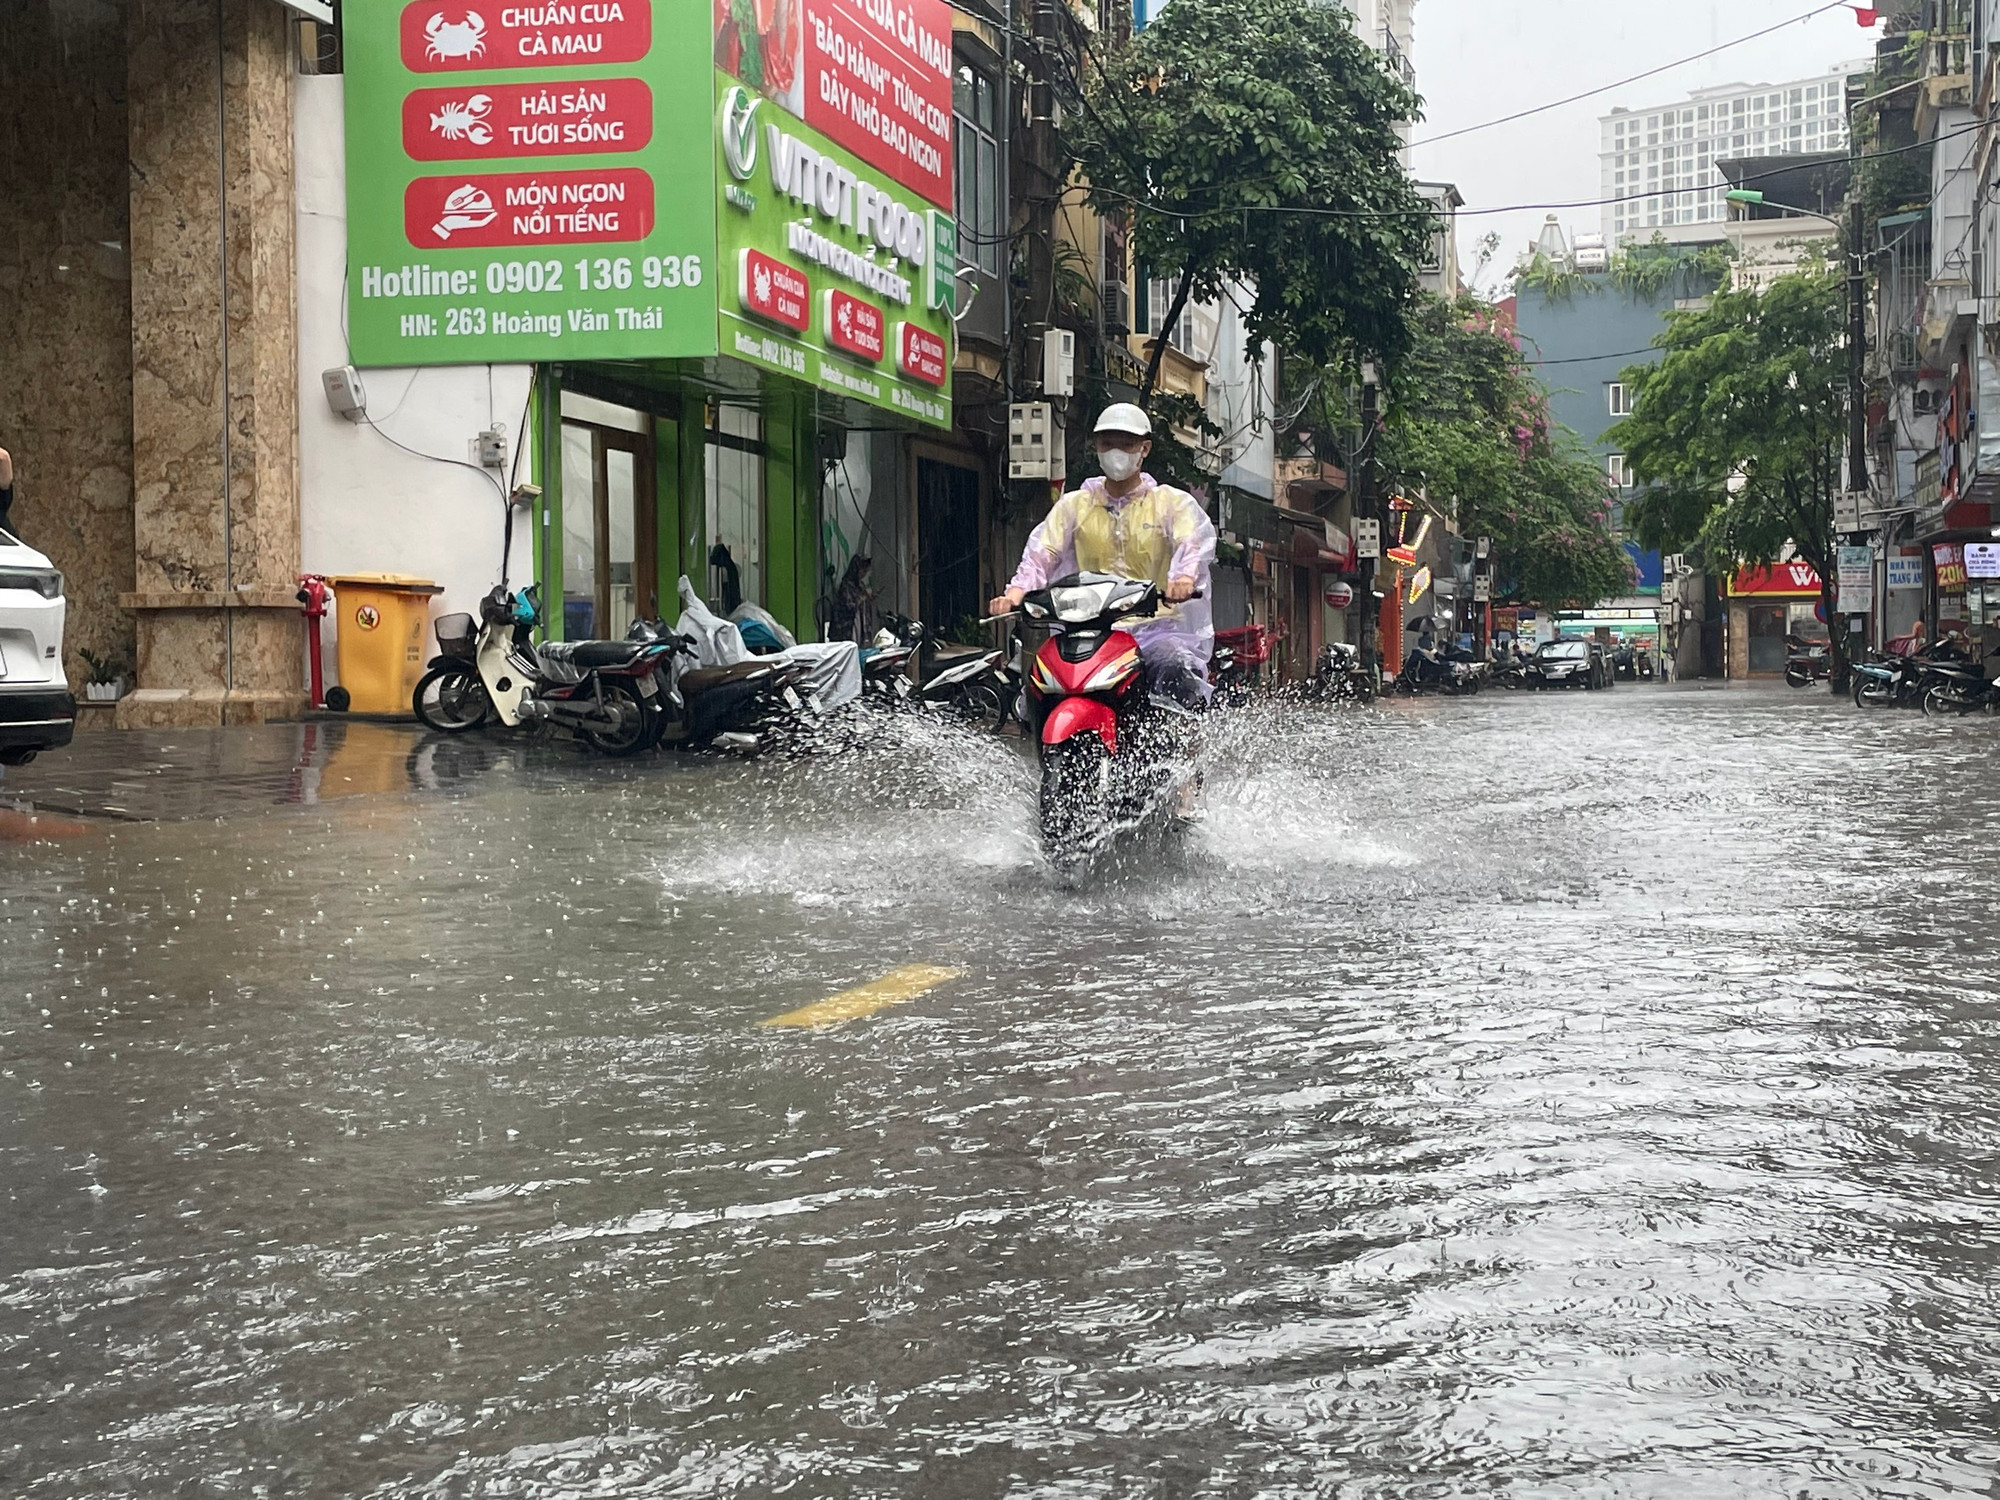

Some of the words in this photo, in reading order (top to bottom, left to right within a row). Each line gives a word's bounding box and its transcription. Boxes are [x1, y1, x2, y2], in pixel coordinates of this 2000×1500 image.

[580, 3, 624, 23] CUA
[519, 30, 548, 56] CÀ
[551, 33, 602, 54] MAU
[897, 4, 917, 54] CÀ
[919, 25, 951, 79] MAU
[521, 89, 557, 115] HẢI
[561, 87, 606, 113] SẢN
[892, 73, 925, 125] TỪNG
[926, 103, 949, 142] CON
[508, 122, 559, 145] TƯƠI
[563, 113, 624, 143] SỐNG
[820, 68, 849, 115] DÂY
[850, 91, 880, 136] NHỎ
[881, 113, 907, 155] BAO
[908, 132, 941, 178] NGON
[506, 180, 557, 206] MÓN
[562, 182, 625, 204] NGON
[766, 123, 857, 227] VITOT
[856, 180, 926, 267] FOOD
[513, 204, 551, 235] NỔI
[554, 203, 619, 233] TIẾNG
[362, 264, 477, 298] Hotline:
[486, 260, 563, 294] 0902
[574, 257, 632, 291] 136
[643, 255, 702, 288] 936
[400, 313, 437, 337] HN:
[445, 307, 487, 336] 263
[492, 310, 562, 338] Hoàng
[567, 308, 609, 333] Văn
[615, 306, 663, 331] Thái
